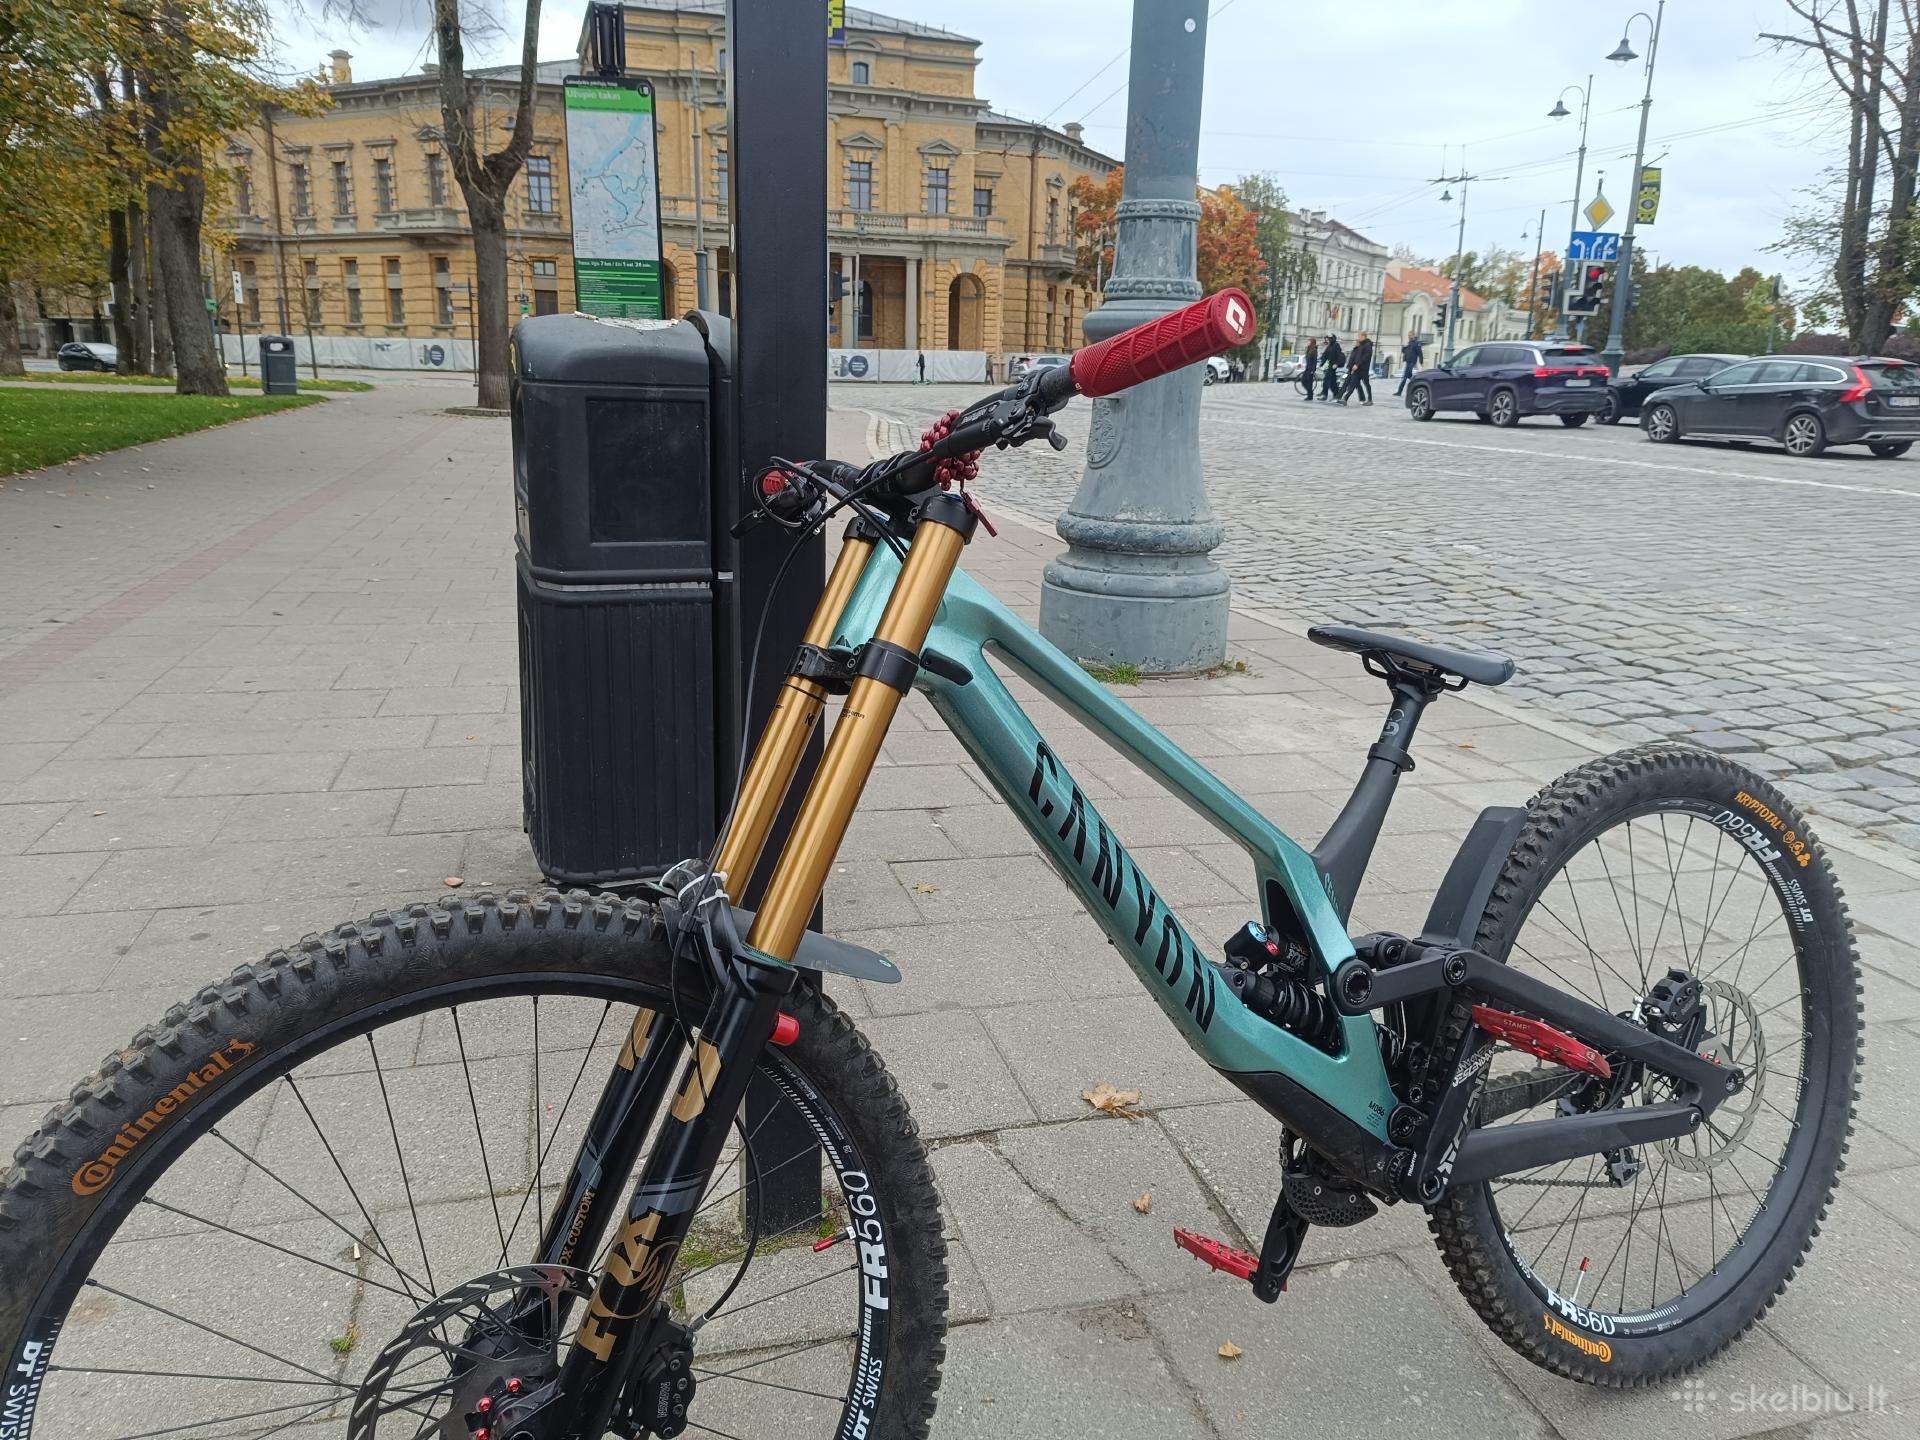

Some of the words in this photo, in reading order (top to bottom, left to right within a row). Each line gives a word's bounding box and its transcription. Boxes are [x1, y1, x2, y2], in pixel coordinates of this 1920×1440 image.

[1712, 810, 1782, 863] FR560
[1734, 791, 1781, 831] KRYPTOTAL
[1029, 741, 1216, 1035] CANYON
[1787, 878, 1808, 906] SWISS
[1800, 906, 1814, 923] DT
[71, 1052, 234, 1196] Continental
[568, 1186, 597, 1247] CUSTOM
[841, 1170, 889, 1310] FR560
[576, 1212, 678, 1363] FOX
[1546, 1286, 1616, 1336] FR560
[17, 1341, 43, 1378] DT
[1550, 1324, 1612, 1363] Continental
[0, 1384, 28, 1440] SWIS
[853, 1409, 871, 1440] DT
[862, 1355, 883, 1409] SWISS
